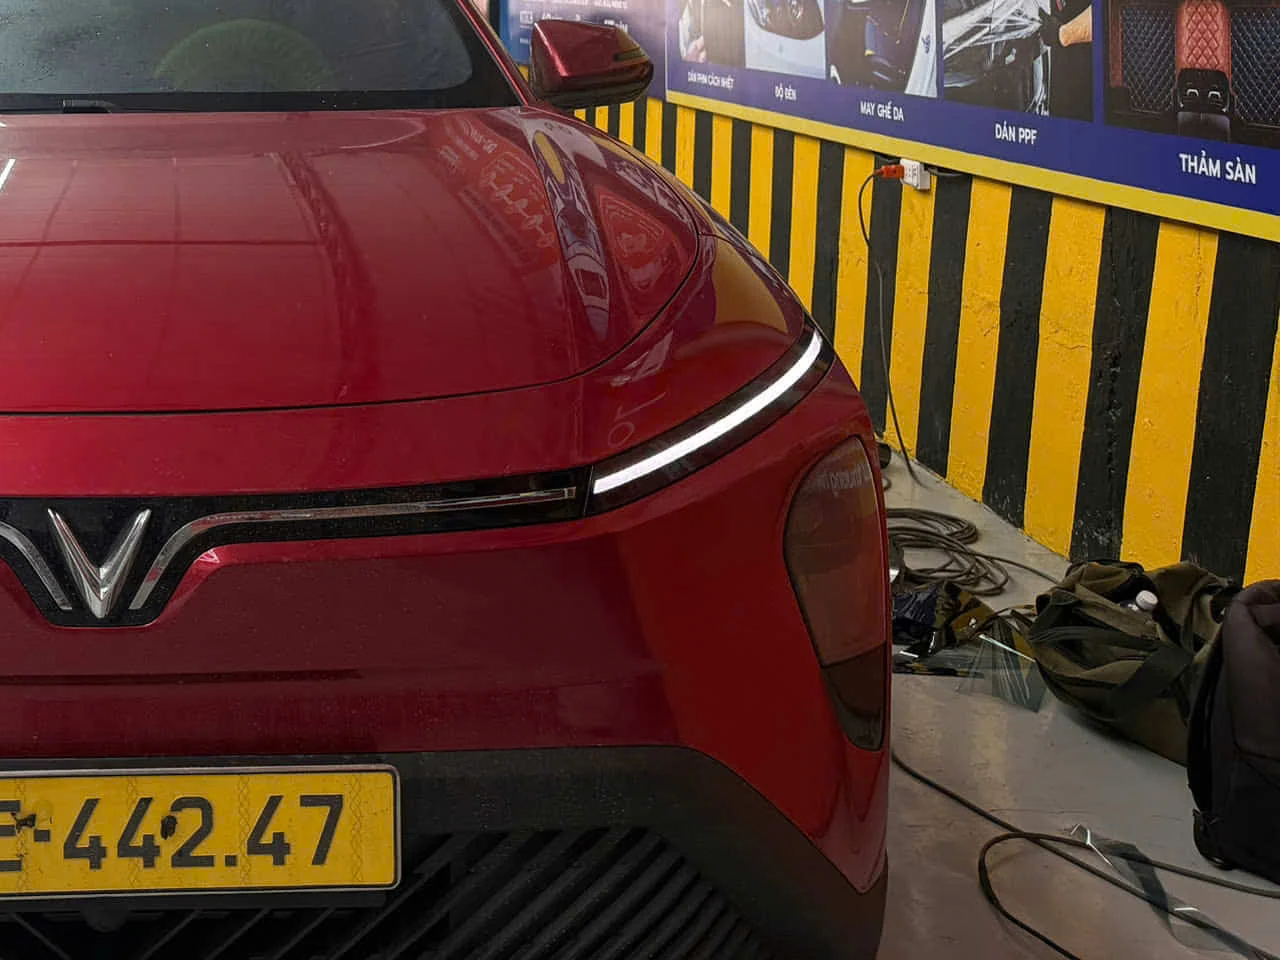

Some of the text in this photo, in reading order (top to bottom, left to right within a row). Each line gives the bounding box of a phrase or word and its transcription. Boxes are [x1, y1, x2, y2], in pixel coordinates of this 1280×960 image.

[860, 99, 905, 122] MAY GHẾ DA
[995, 121, 1038, 145] DÁN PPF
[1179, 149, 1257, 185] THẢM SÀN
